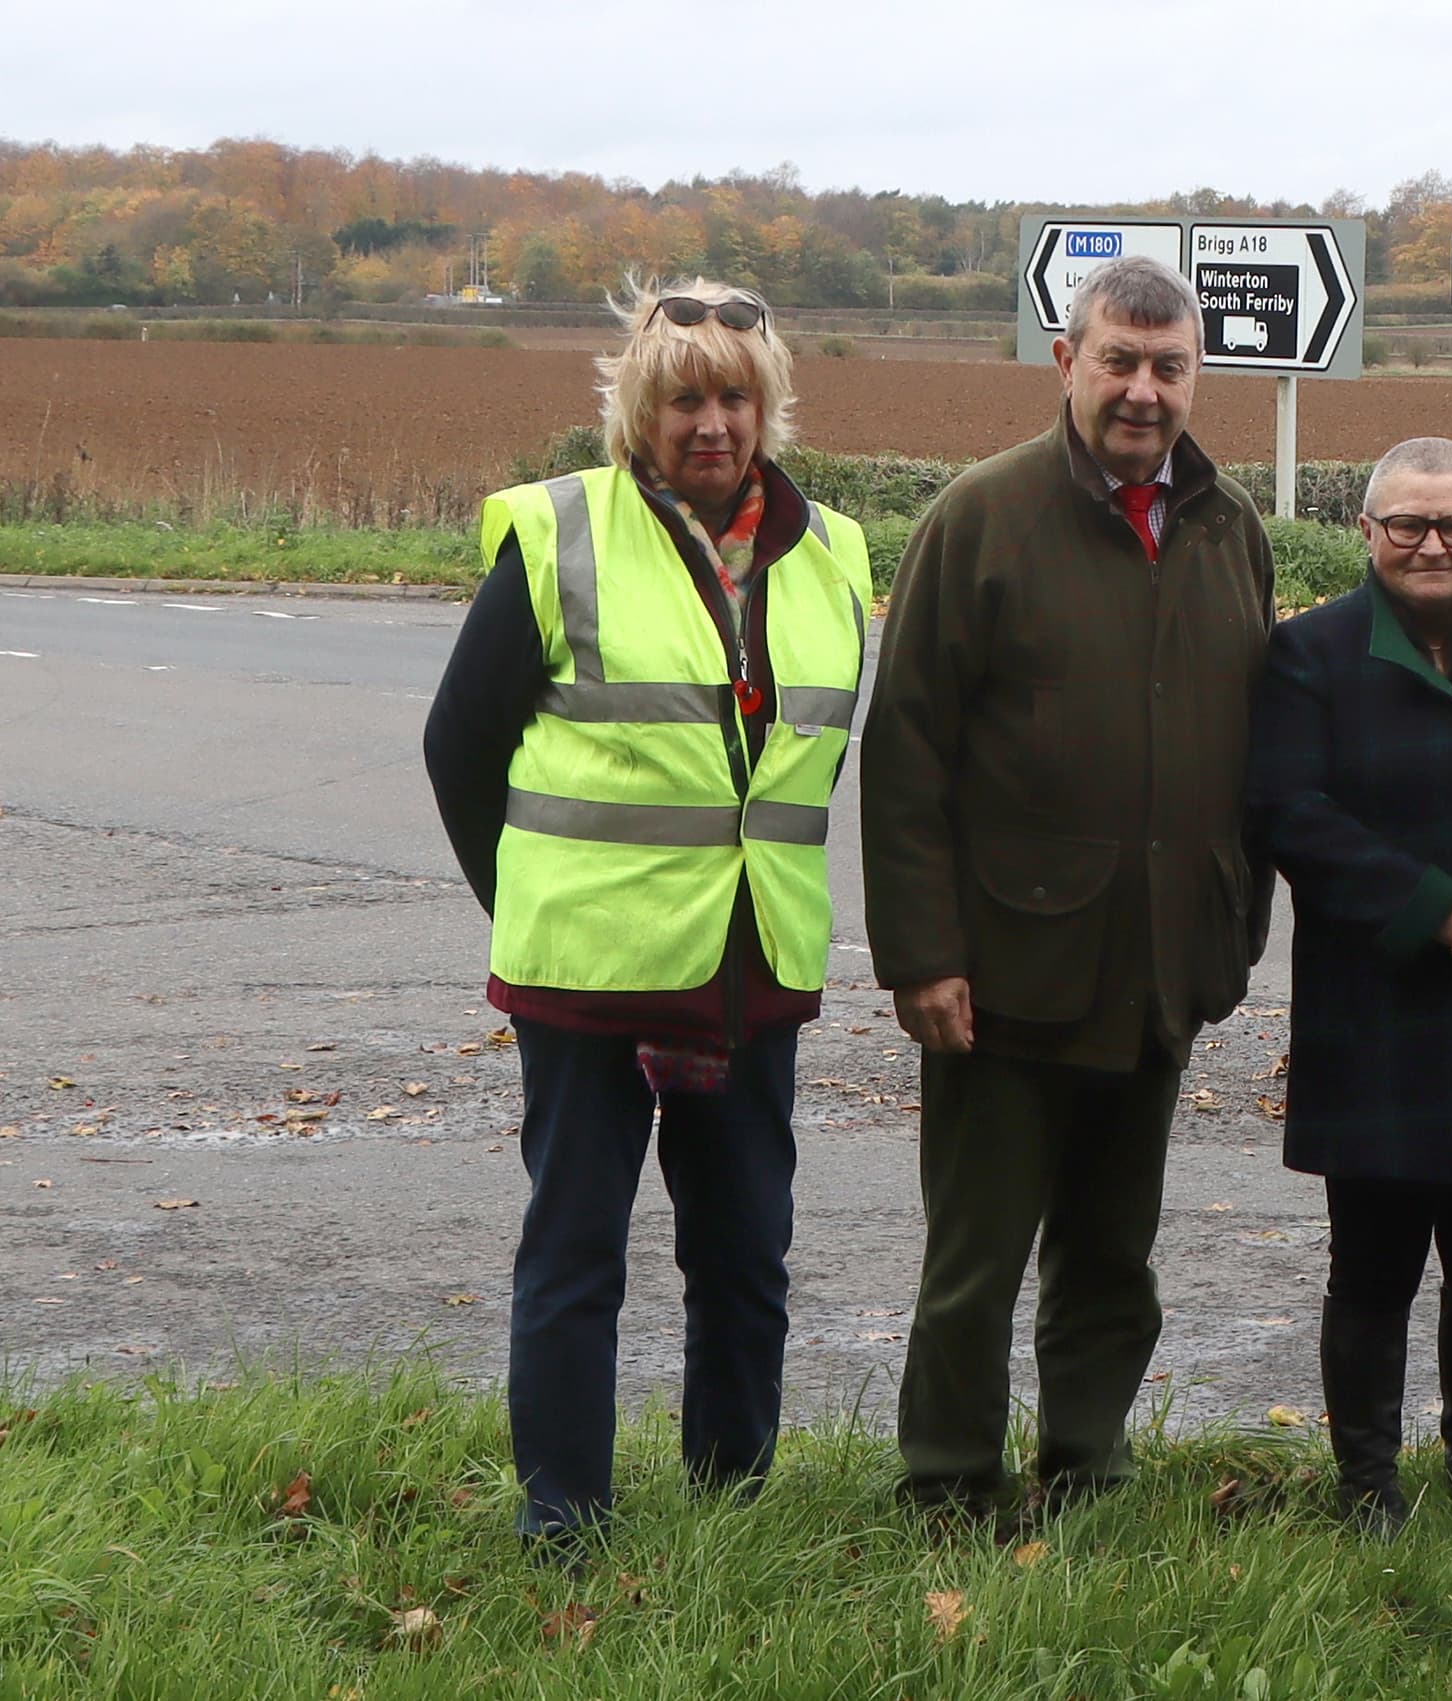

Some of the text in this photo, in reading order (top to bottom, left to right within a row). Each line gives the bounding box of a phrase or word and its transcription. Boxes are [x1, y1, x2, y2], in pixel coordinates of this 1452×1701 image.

[1199, 235, 1267, 255] Brigg A18
[1201, 270, 1268, 289] Winterton
[1200, 292, 1294, 315] South Ferriby
